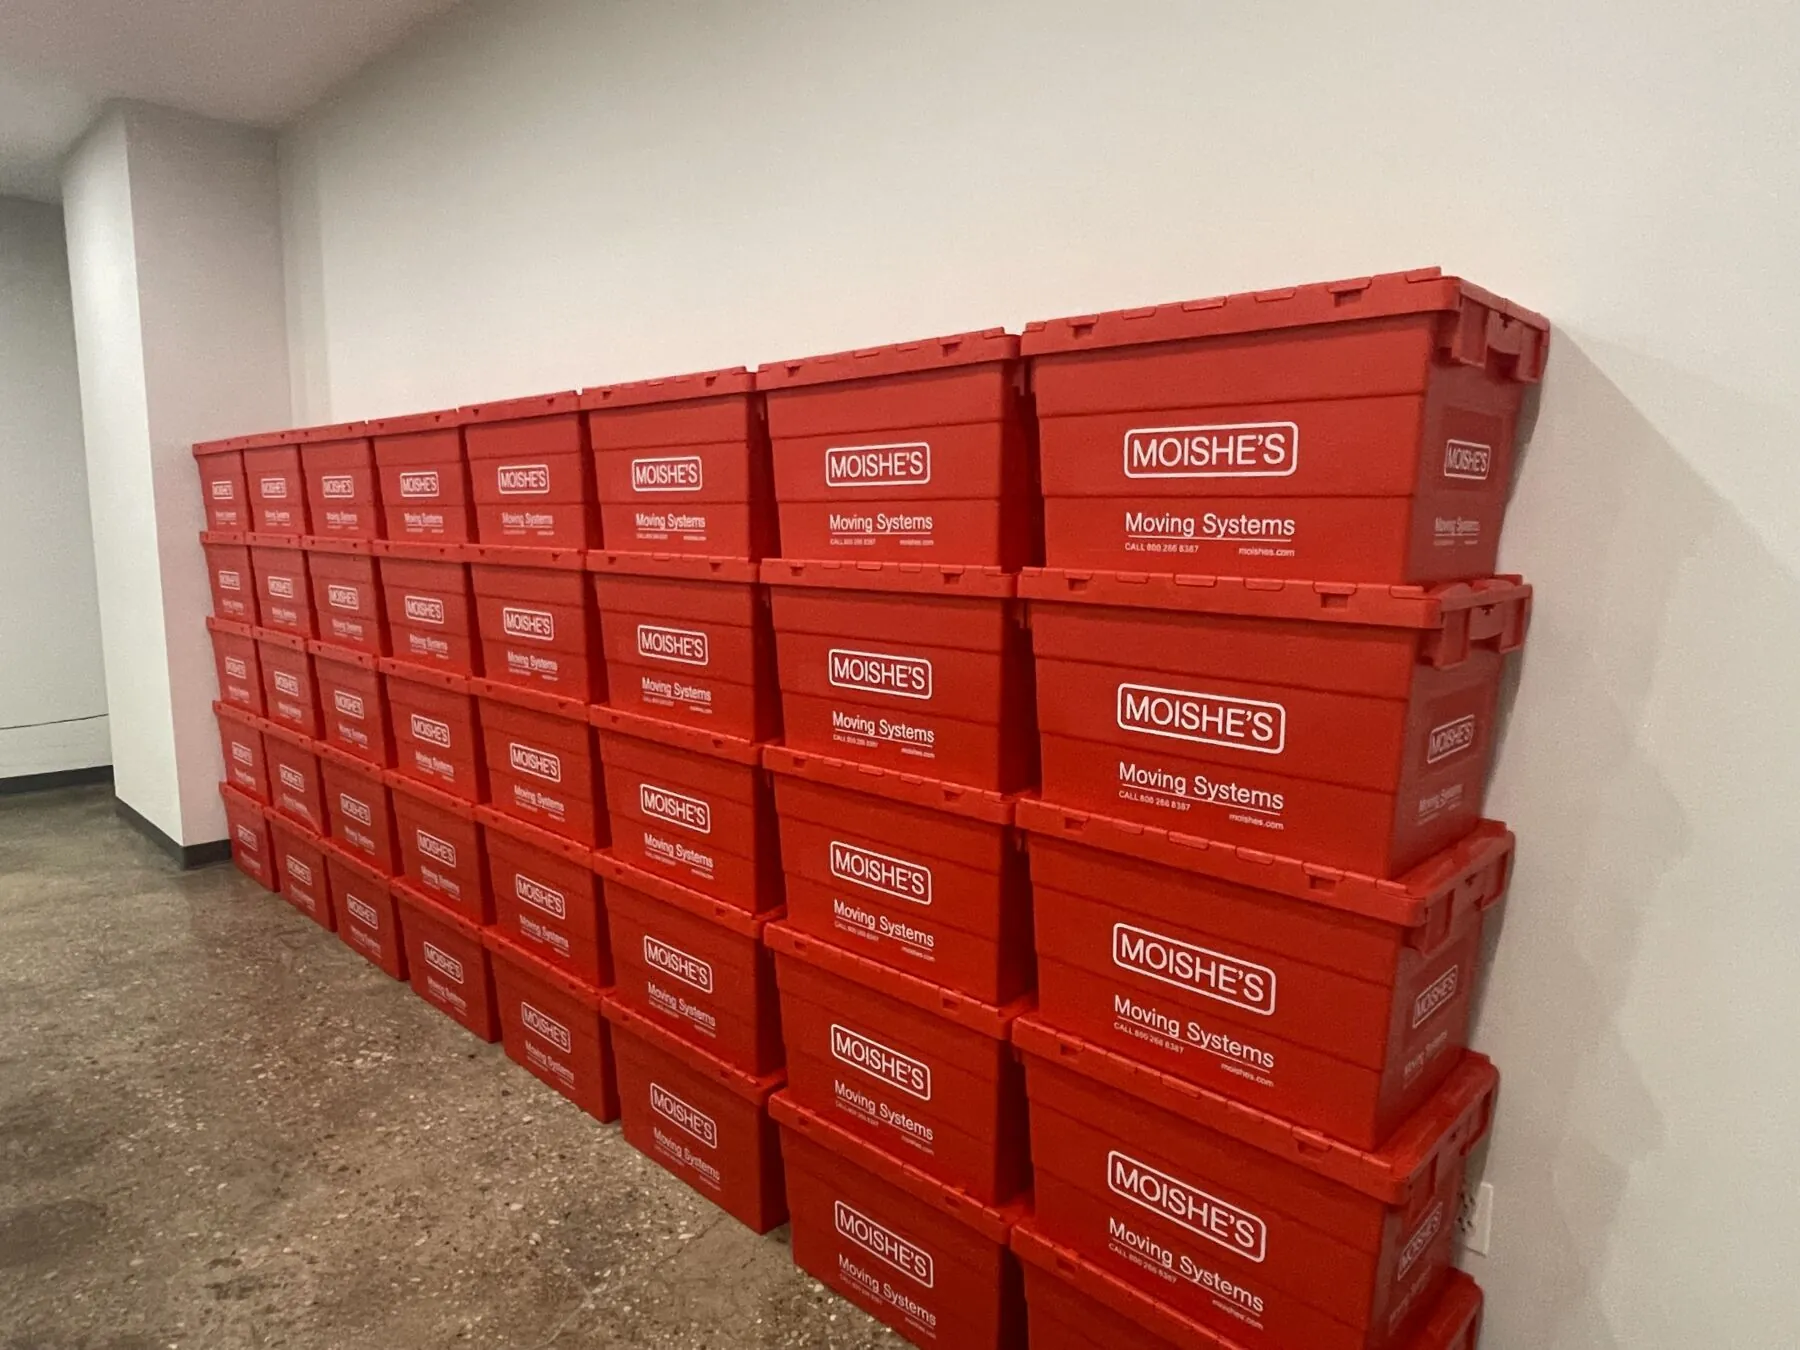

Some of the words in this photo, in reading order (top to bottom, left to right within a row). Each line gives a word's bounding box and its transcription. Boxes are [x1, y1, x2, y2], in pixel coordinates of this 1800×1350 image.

[831, 451, 923, 479] MOISHE'S
[1133, 434, 1286, 468] MOISHE'S
[635, 464, 698, 485] MOISHE'S
[636, 513, 666, 530] Moving
[667, 513, 706, 530] Systems
[829, 513, 873, 533] Moving
[877, 513, 933, 533] Systems
[1125, 512, 1195, 538] Moving
[1202, 513, 1296, 538] Systems
[1124, 542, 1145, 552] CALL
[1238, 547, 1296, 557] moishes.com
[641, 631, 703, 658] MOISHE'S
[641, 676, 672, 697] Moving
[674, 682, 712, 702] Systems
[834, 657, 925, 690] MOISHE'S
[832, 710, 876, 736] Moving
[879, 719, 935, 743] Systems
[1126, 693, 1273, 742] MOISHE'S
[1118, 760, 1187, 796] Moving
[1194, 775, 1284, 811] Systems
[1118, 789, 1138, 801] CALL
[644, 790, 706, 826] MOISHE'S
[644, 832, 674, 856] Moving
[676, 844, 713, 868] Systems
[835, 849, 925, 895] MOISHE'S
[833, 899, 876, 930] Moving
[879, 915, 934, 948] Systems
[647, 942, 708, 986] MOISHE'S
[1121, 933, 1265, 1002] MOISHE'S
[647, 981, 677, 1009] Moving
[678, 998, 715, 1027] Systems
[1113, 1021, 1133, 1036] CALL
[1114, 994, 1180, 1038] Moving
[1187, 1022, 1274, 1069] Systems
[836, 1032, 924, 1090] MOISHE'S
[653, 1089, 713, 1140] MOISHE'S
[834, 1079, 876, 1115] Moving
[879, 1103, 933, 1142] Systems
[1116, 1160, 1255, 1248] MOISHE'S
[839, 1208, 927, 1277] MOISHE'S
[1109, 1217, 1173, 1268] Moving
[1179, 1256, 1264, 1313] Systems
[838, 1253, 880, 1293] Moving
[883, 1283, 936, 1328] Systems
